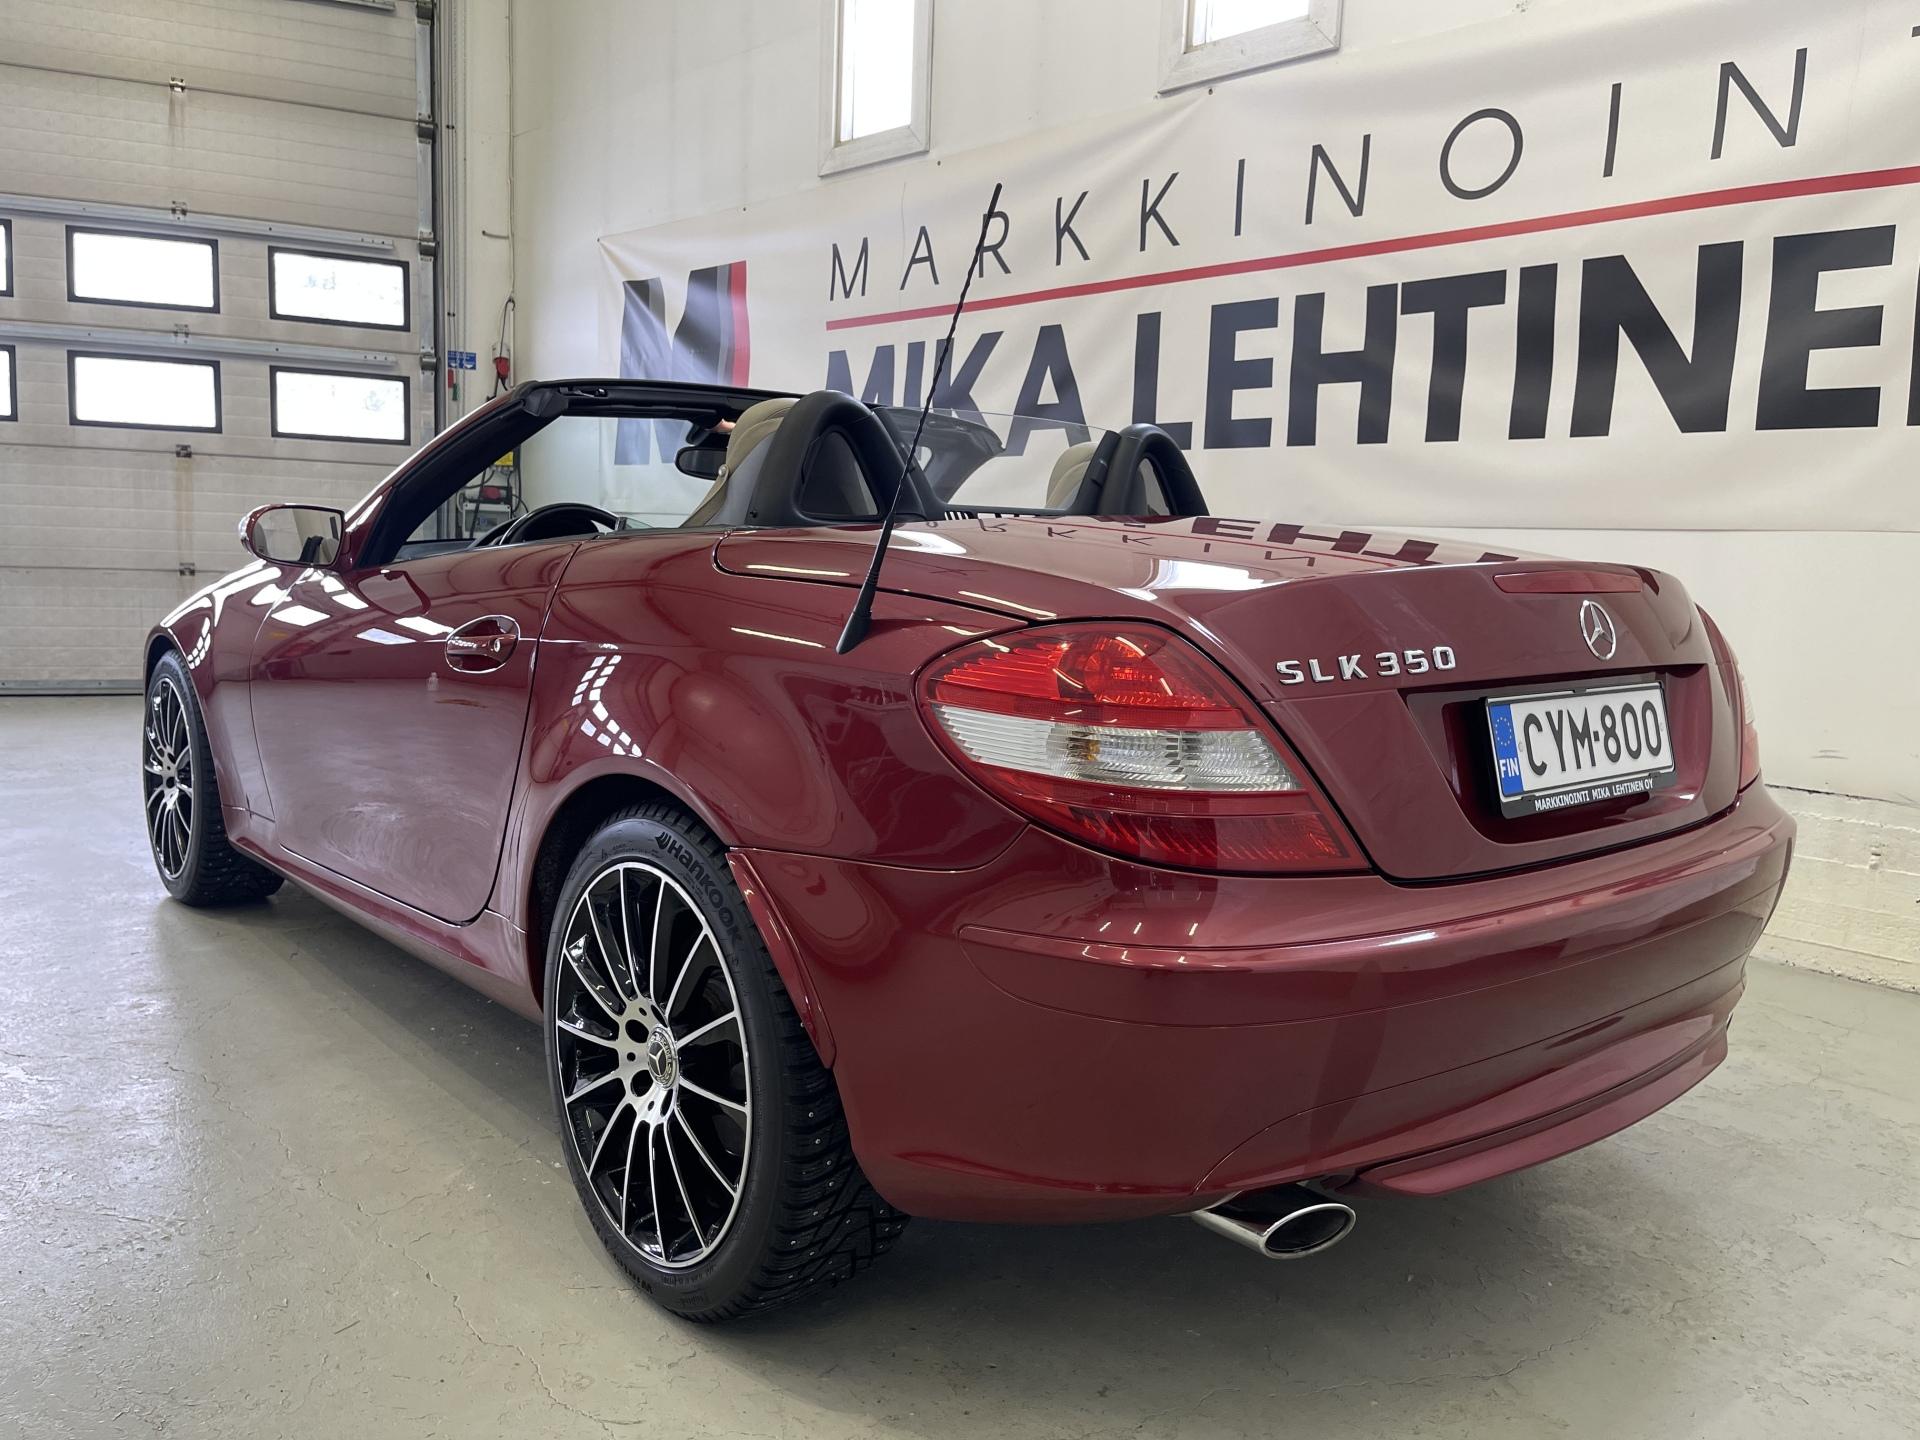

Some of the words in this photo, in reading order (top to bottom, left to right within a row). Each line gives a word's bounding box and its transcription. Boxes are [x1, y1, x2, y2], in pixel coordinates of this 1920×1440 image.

[828, 26, 1920, 302] MARKKINOIN
[1131, 224, 1920, 450] LEHTINE
[1276, 654, 1369, 684] SLK
[1375, 646, 1456, 676] 350
[1523, 700, 1662, 776] CYM-800
[1499, 758, 1519, 778] FIN
[1534, 791, 1590, 811] MARKKINOINTI
[1592, 788, 1611, 800] MIKA
[1613, 780, 1645, 795] LEHTINEN
[1644, 777, 1654, 789] OY
